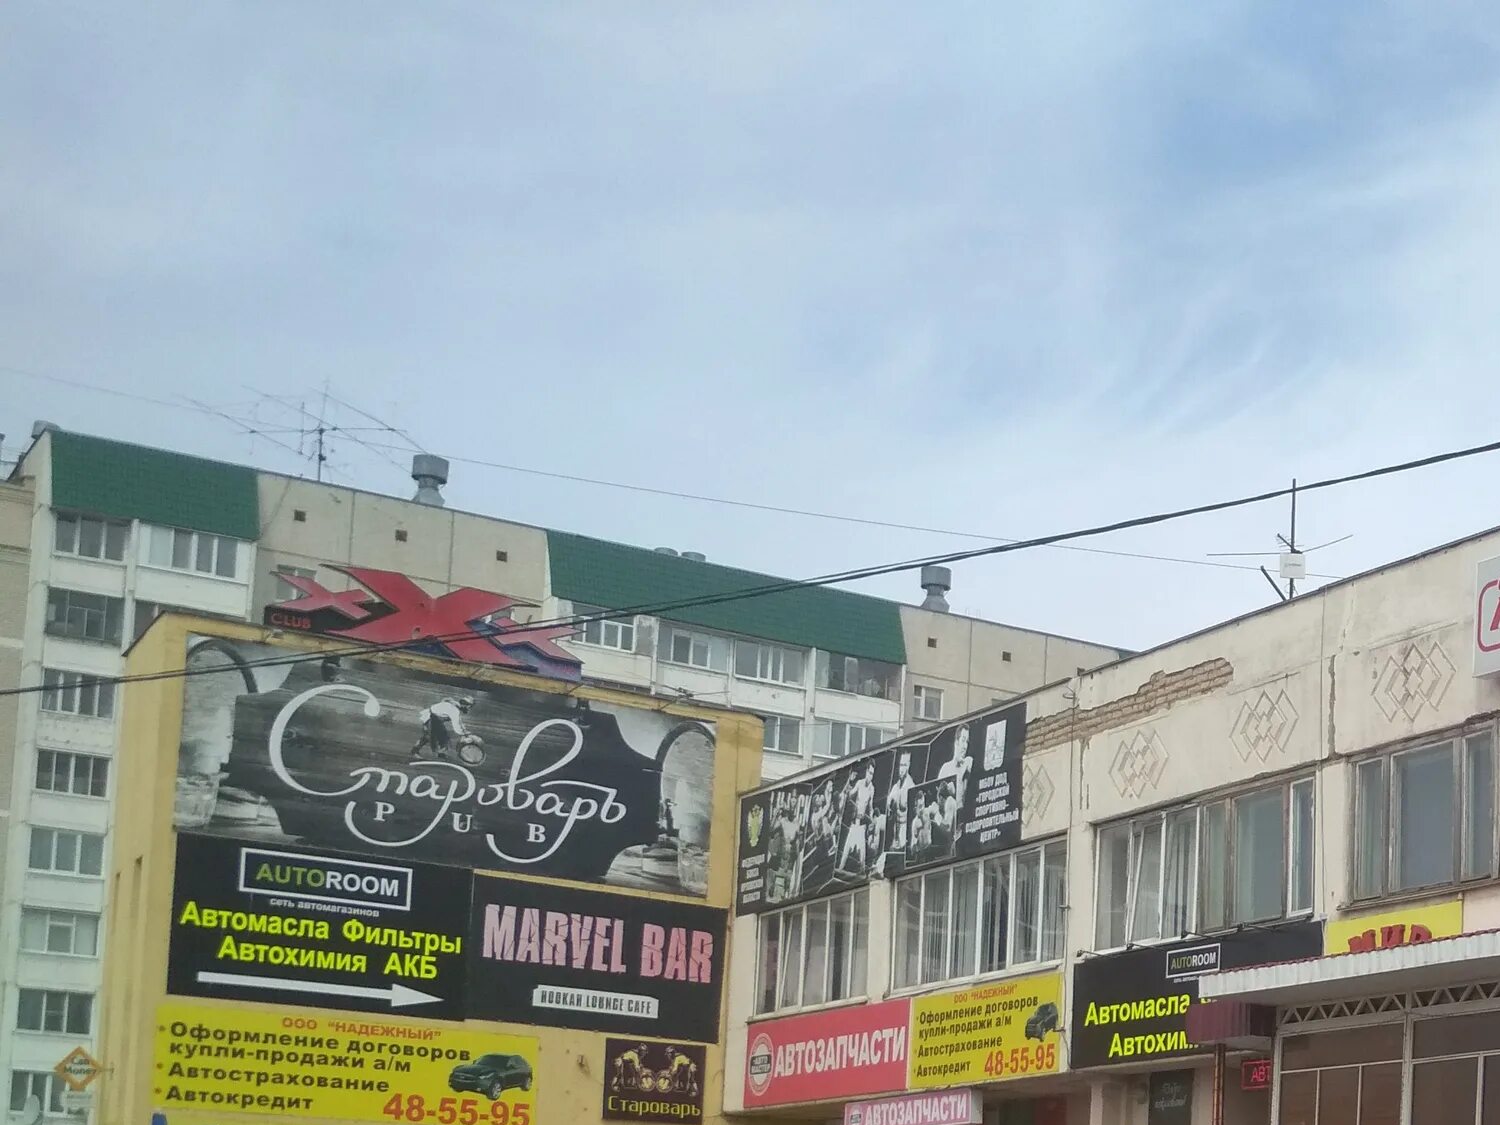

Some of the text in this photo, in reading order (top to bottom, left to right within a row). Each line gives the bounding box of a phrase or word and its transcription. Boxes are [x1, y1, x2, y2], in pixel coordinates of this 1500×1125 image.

[270, 613, 312, 630] CLUB
[269, 684, 627, 863] Староварь
[256, 863, 399, 898] AUTOROOM
[270, 898, 380, 917] сеть автомагазинов
[180, 901, 463, 956] Автомасла Фильтры
[483, 903, 714, 983] MARVEL BAR
[217, 936, 439, 979] Автохимия АКБ
[1171, 952, 1217, 969] AUTOROOM
[541, 990, 652, 1014] HOOKAH LOUNGE CAFE
[919, 996, 1039, 1025] Оформление договоров
[954, 994, 968, 1004] ООО
[1084, 994, 1191, 1026] Автомасла
[282, 1017, 318, 1030] ООО
[918, 1015, 1012, 1041] купли-продажи а/м
[170, 1021, 472, 1062] Оформление договоров
[774, 1026, 906, 1078] АВТОЗАПЧАСТИ
[917, 1036, 1003, 1058] Автострахование
[169, 1043, 411, 1073] купли-продажи а/м
[916, 1059, 971, 1078] Автокредит
[984, 1043, 1055, 1077] 48-55-95
[168, 1062, 390, 1092] Автострахование
[1251, 1065, 1271, 1083] АВТ
[165, 1085, 313, 1110] Автокредит
[607, 1096, 701, 1119] Староварь
